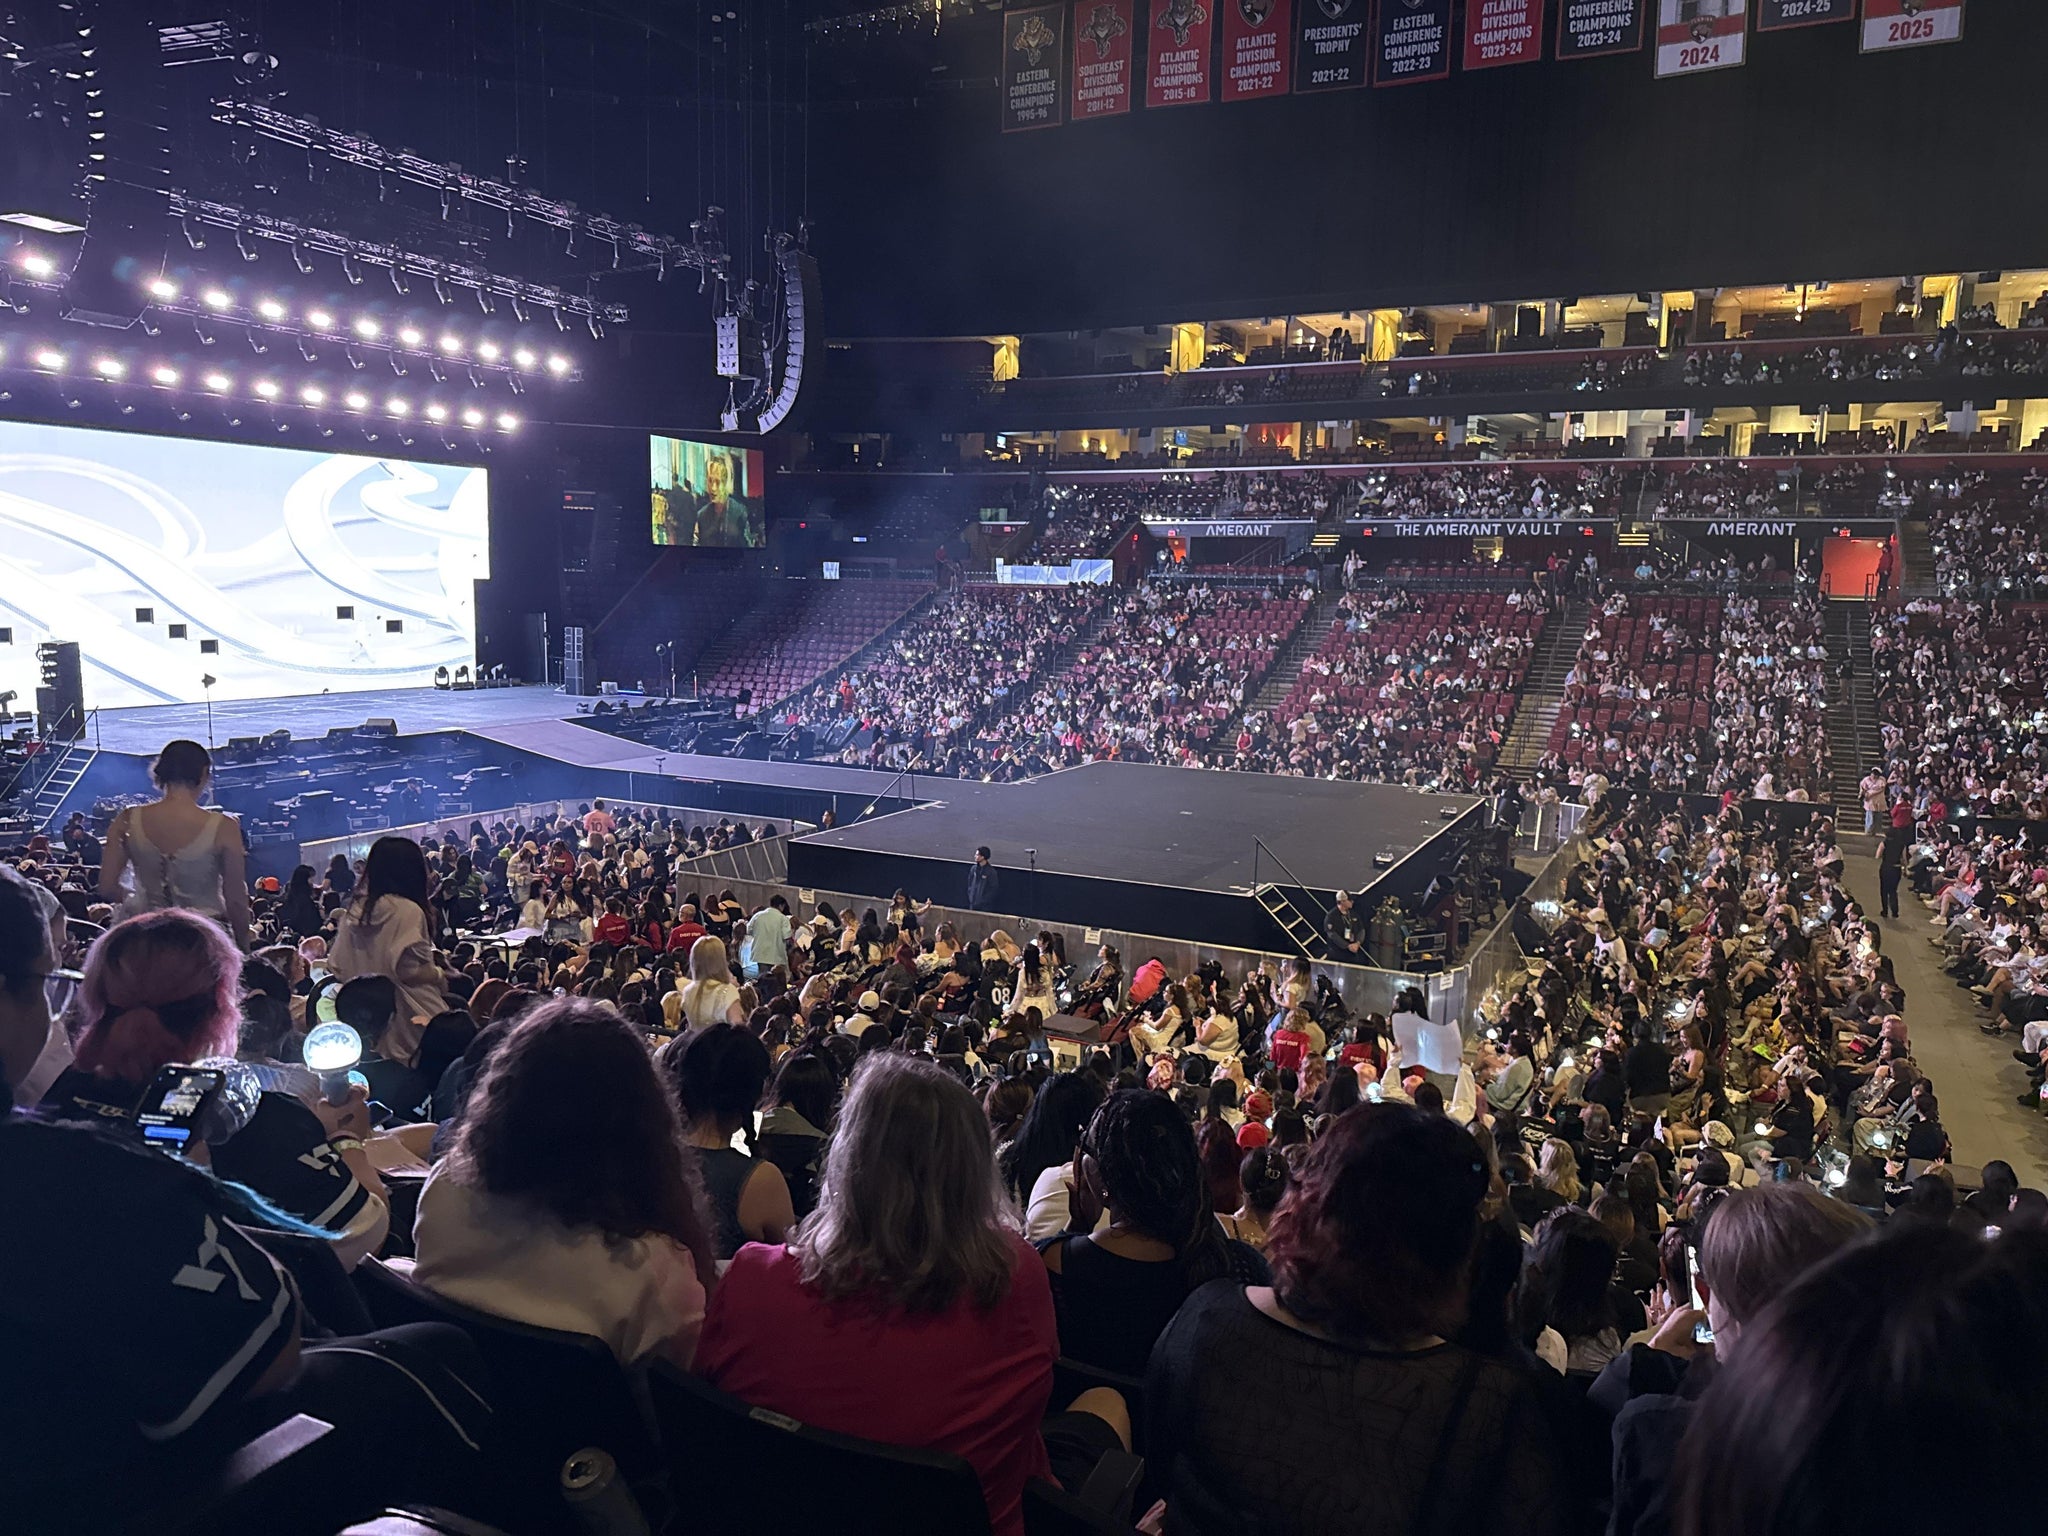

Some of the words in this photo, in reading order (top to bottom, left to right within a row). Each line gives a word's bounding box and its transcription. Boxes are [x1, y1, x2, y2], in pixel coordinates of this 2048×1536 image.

[1482, 0, 1528, 15] ATLANTIC
[1569, 0, 1634, 18] CONFERENCE
[1782, 0, 1831, 17] 2024-25
[1393, 13, 1435, 30] EASTERN
[1482, 11, 1526, 29] DIVISION
[1570, 13, 1632, 33] CHAMPIONS
[1304, 23, 1362, 41] PRESIDENTS'
[1384, 26, 1442, 46] CONFERENCE
[1474, 26, 1532, 45] CHAMPIONS
[1888, 18, 1934, 42] 2025
[1236, 33, 1276, 49] ATLANTIC
[1315, 39, 1351, 54] TROPHY
[1577, 30, 1621, 48] 2023-24
[1160, 49, 1199, 63] ATLANTIC
[1237, 48, 1275, 64] DIVISION
[1384, 41, 1440, 60] CHAMPIONS
[1481, 42, 1522, 59] 2023-24
[1679, 44, 1720, 68] 2024
[1080, 60, 1124, 76] SOUTHEAST
[1160, 62, 1197, 75] DIVISION
[1230, 61, 1280, 78] CHAMPIONS
[1392, 56, 1431, 73] 2022-23
[1016, 68, 1050, 83] EASTERN
[1084, 73, 1119, 88] DIVISION
[1153, 72, 1203, 88] CHAMPIONS
[1238, 76, 1273, 91] 2021-22
[1312, 68, 1349, 83] 2021-22
[1010, 80, 1056, 97] CONFERENCE
[1078, 84, 1124, 100] CHAMPIONS
[1163, 87, 1196, 100] 2015-16
[1010, 94, 1054, 110] CHAMPIONS
[1087, 99, 1114, 112] 2011-12
[1017, 107, 1048, 121] 1995-96
[1206, 525, 1272, 536] AMERANT
[1394, 524, 1420, 536] THE
[1424, 524, 1502, 536] AMERANT
[1507, 523, 1562, 535] VAULT
[1706, 523, 1796, 536] AMERANT
[992, 987, 1010, 1005] 08
